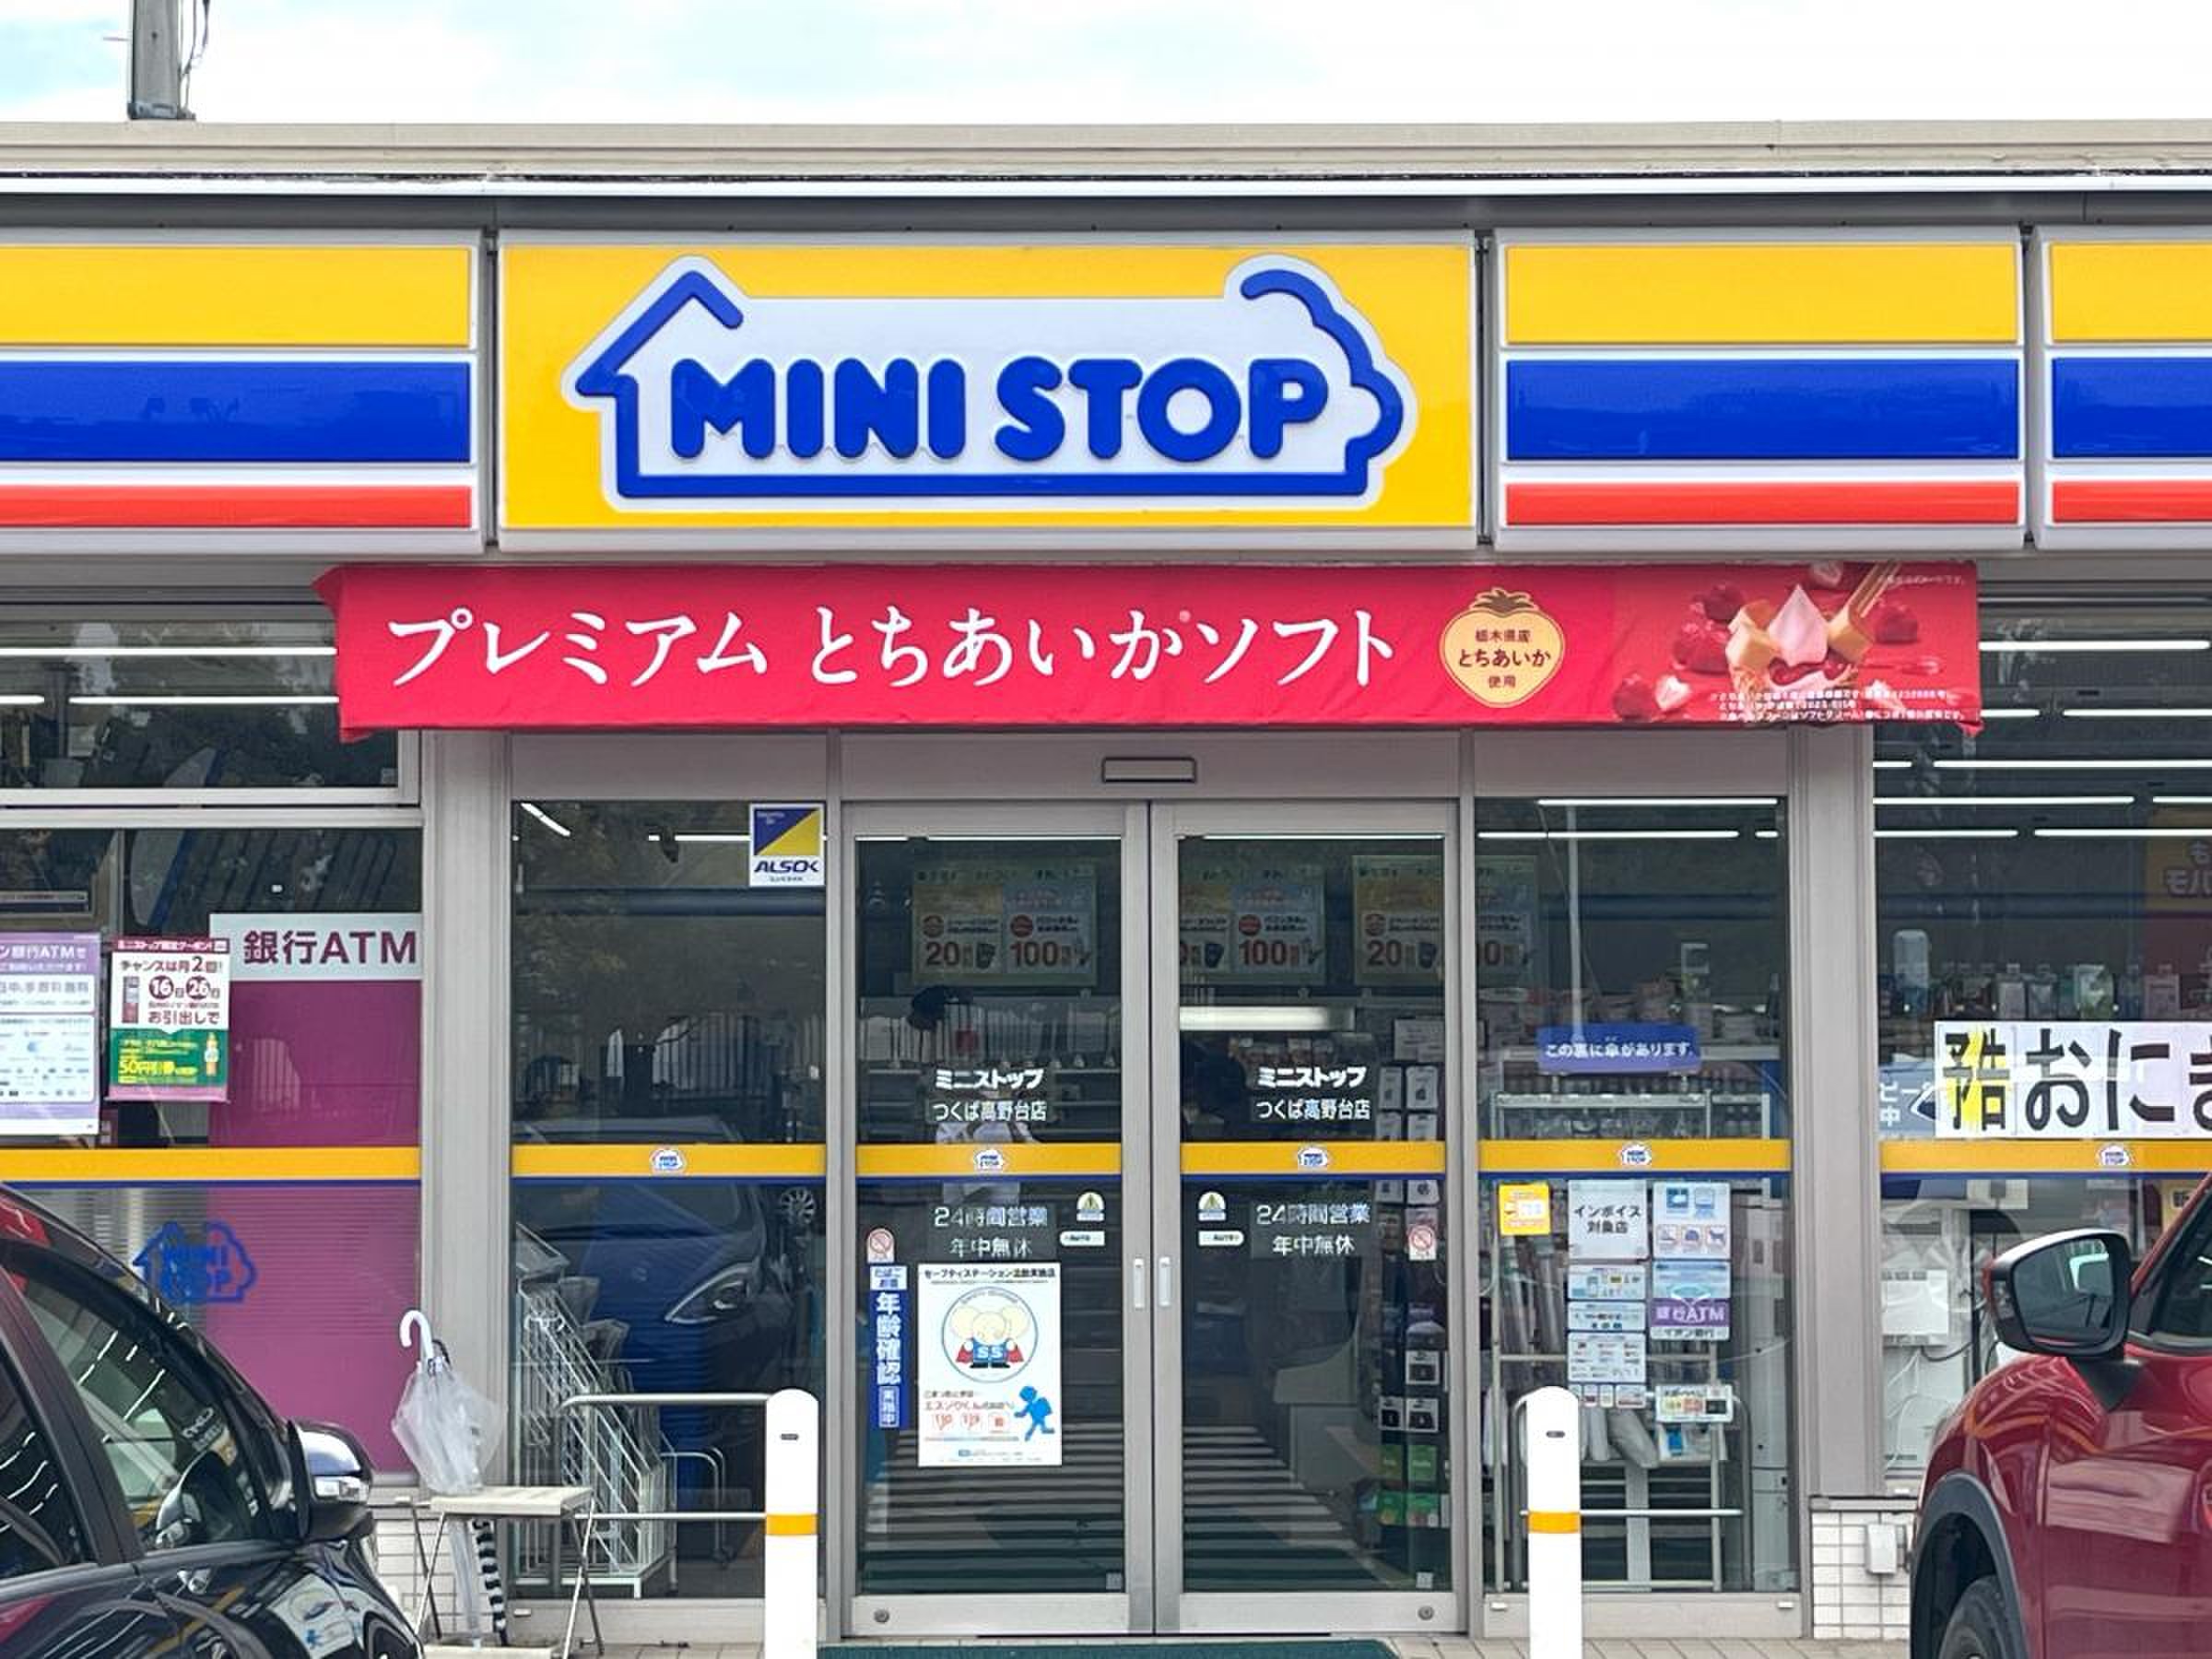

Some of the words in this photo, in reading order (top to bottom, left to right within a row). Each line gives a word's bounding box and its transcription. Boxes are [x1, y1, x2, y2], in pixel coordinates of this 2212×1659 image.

[672, 358, 966, 459] MINI
[994, 355, 1328, 462] STOP
[388, 606, 768, 688] プレミアム
[1459, 648, 1552, 668] とちあいか
[1488, 675, 1517, 689] 使用
[754, 860, 819, 874] ALSOK
[243, 929, 417, 965] 銀行ATM
[935, 1068, 1044, 1090] ミニストップ
[1257, 1065, 1368, 1088] ミニストップ
[933, 1100, 1048, 1122] つくば高野台店
[1255, 1098, 1371, 1121] つくば高野台店
[934, 1206, 1049, 1227] 24時間営業
[1255, 1204, 1372, 1226] 24時間営業
[1573, 1204, 1641, 1218] インボイス
[949, 1237, 1033, 1258] 年中無休
[1272, 1234, 1356, 1255] 年中無休
